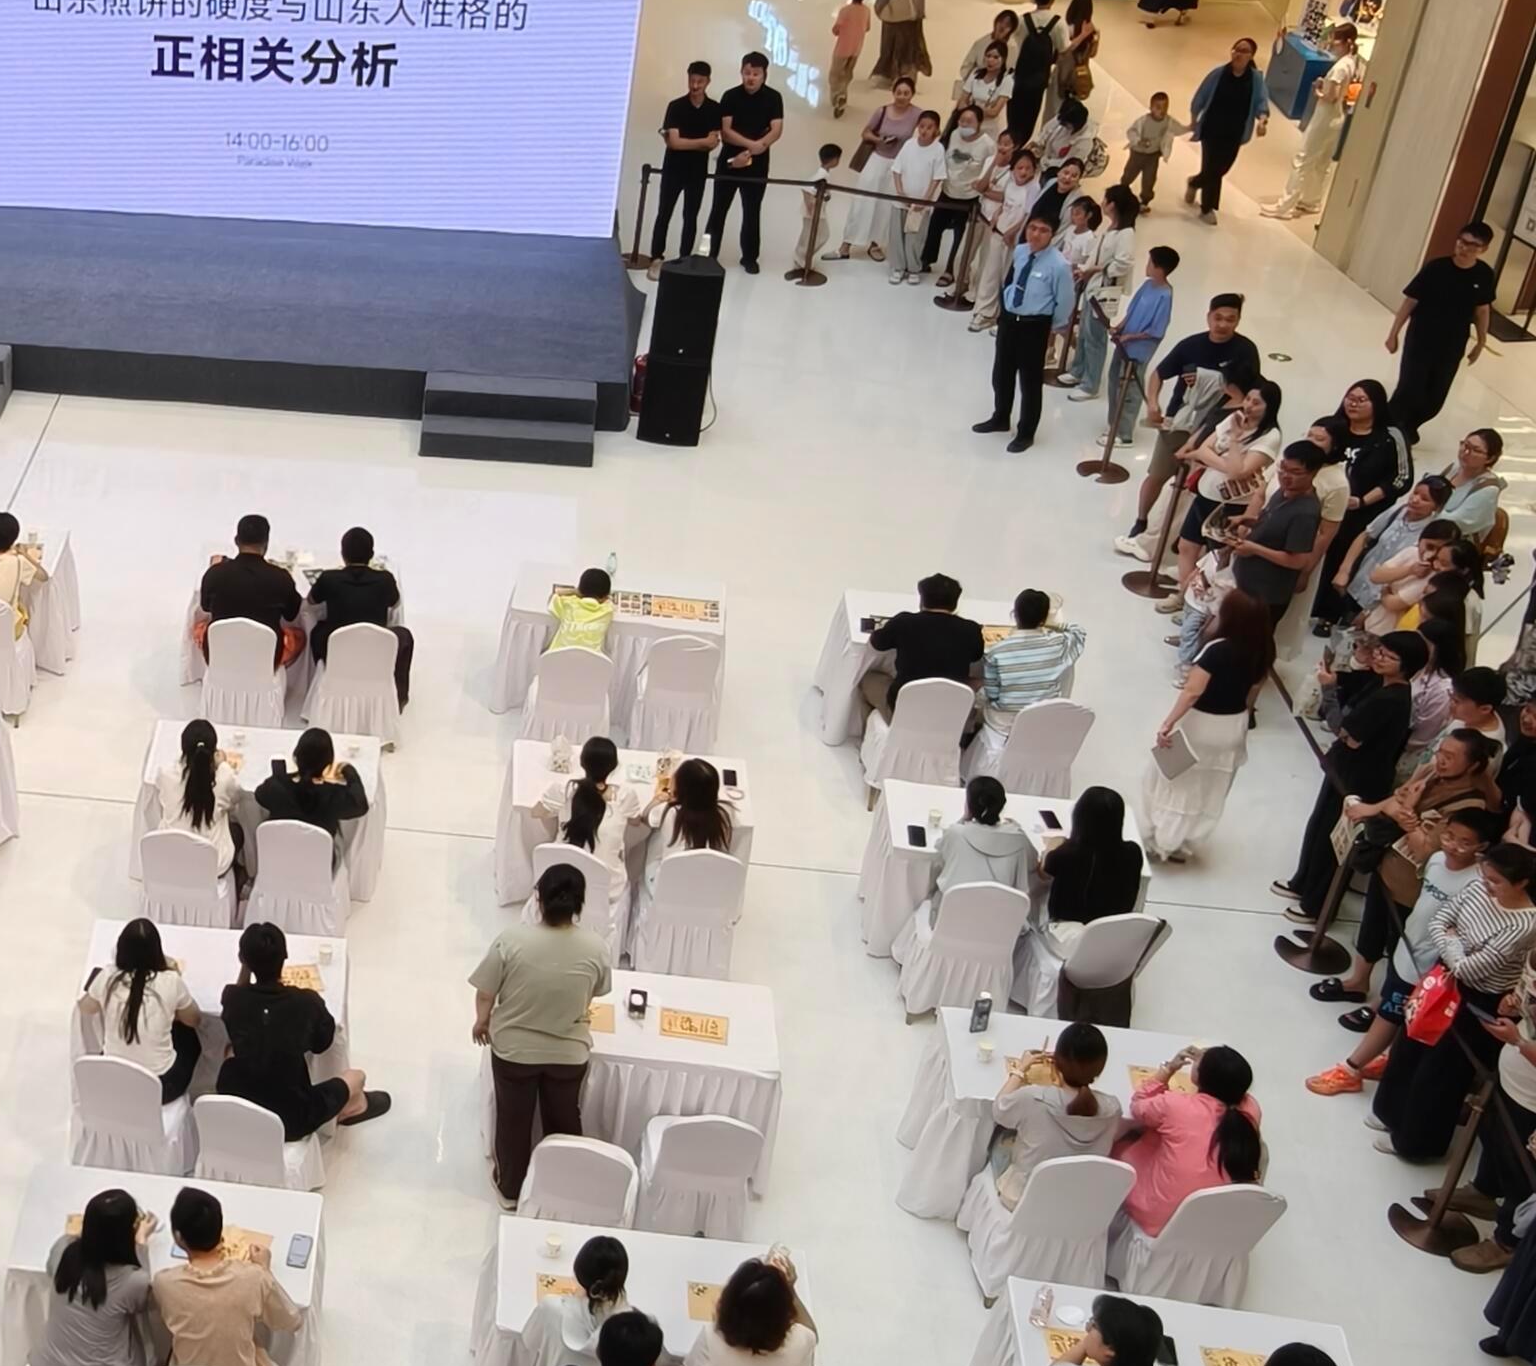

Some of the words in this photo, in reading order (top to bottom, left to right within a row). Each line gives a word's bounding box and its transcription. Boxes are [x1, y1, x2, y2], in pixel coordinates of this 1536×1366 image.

[151, 34, 399, 88] 正相关分析
